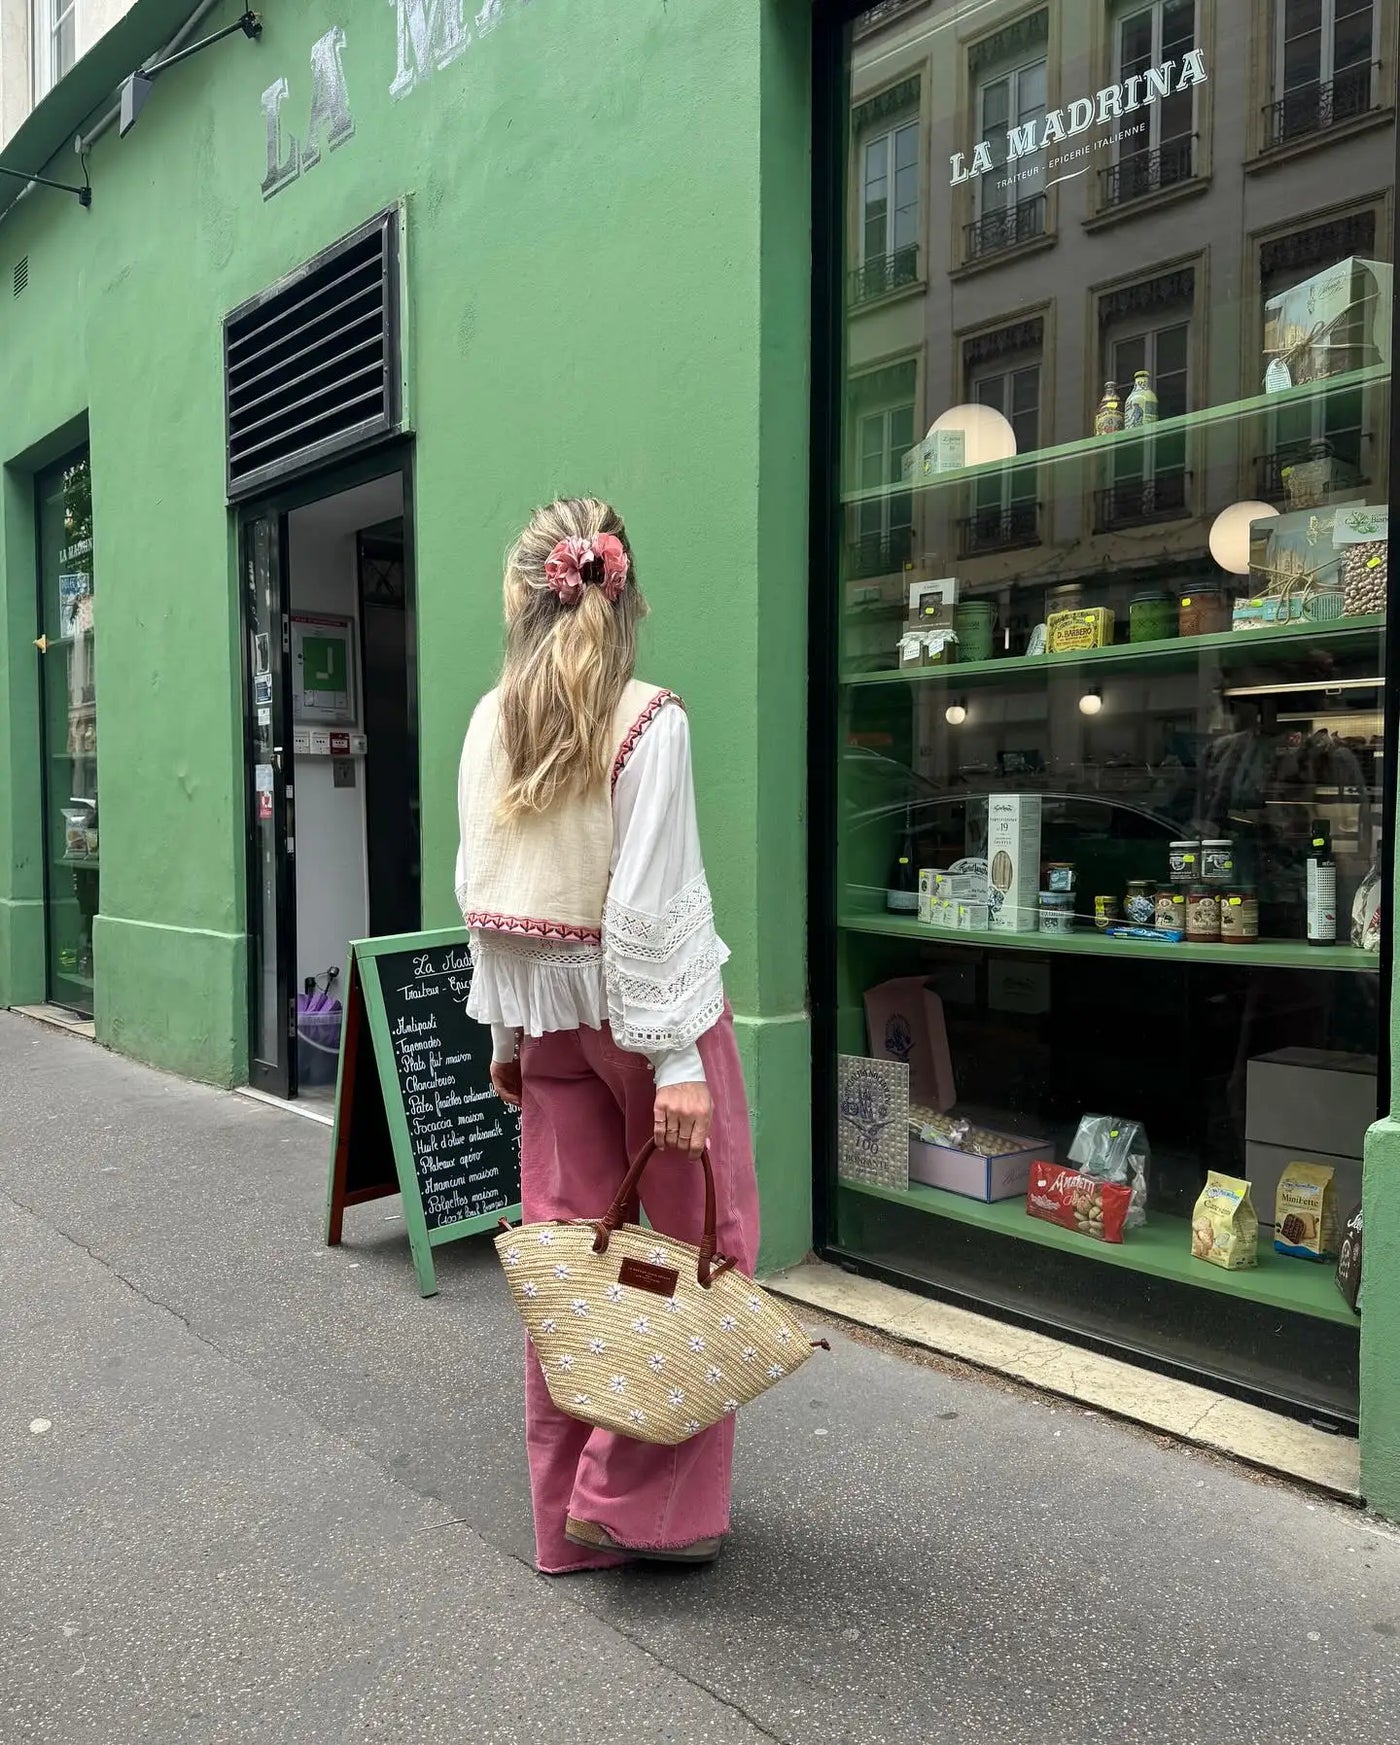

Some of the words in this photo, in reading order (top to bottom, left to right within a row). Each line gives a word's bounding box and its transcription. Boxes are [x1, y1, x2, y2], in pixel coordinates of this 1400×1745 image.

[260, 26, 355, 202] LA
[388, 0, 505, 102] M
[949, 140, 994, 187] LA
[1006, 48, 1208, 162] MADRINA
[996, 165, 1039, 189] TRAITEUR
[1048, 145, 1090, 169] EPICERIE
[1093, 122, 1146, 150] ITALIENNE
[412, 953, 436, 975] La
[396, 982, 439, 1001] Traiteur
[855, 1135, 879, 1155] 100
